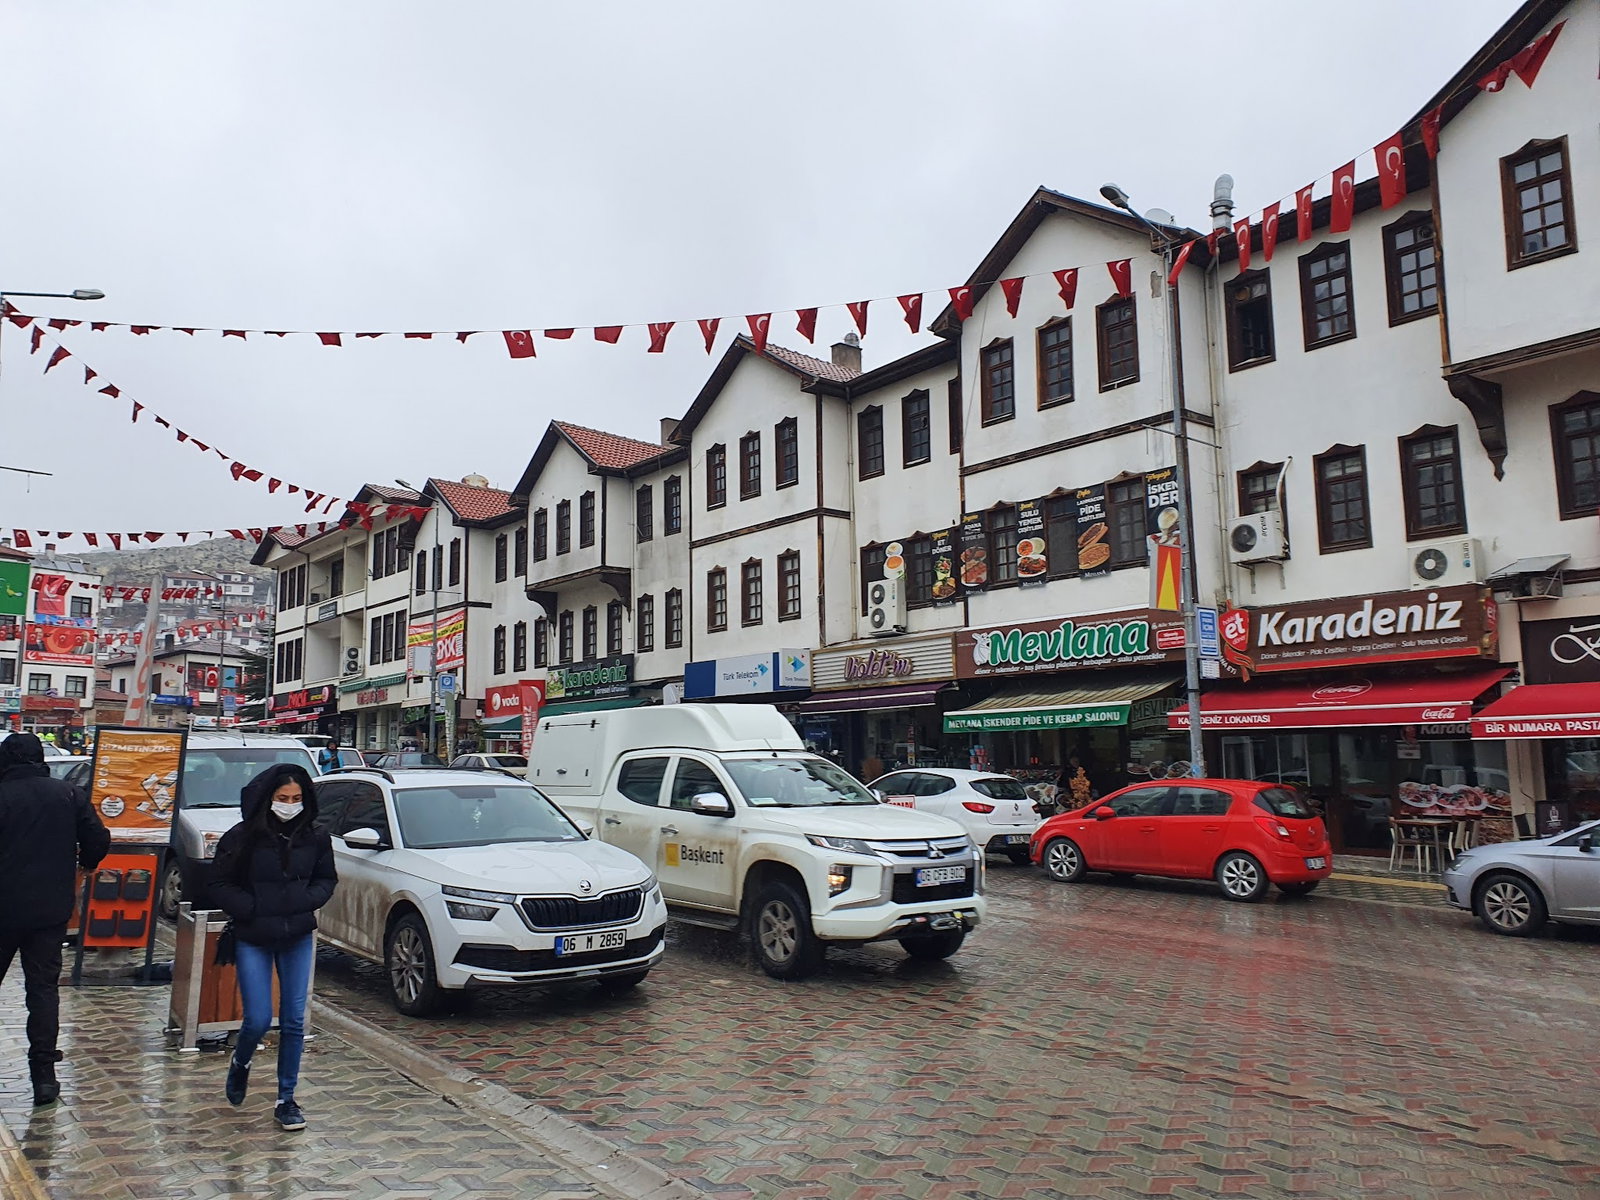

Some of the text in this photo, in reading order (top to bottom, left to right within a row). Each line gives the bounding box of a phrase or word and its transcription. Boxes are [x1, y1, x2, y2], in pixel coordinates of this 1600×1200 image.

[1148, 490, 1178, 508] DER
[1080, 504, 1101, 516] PİDE
[1225, 612, 1246, 638] et
[1258, 592, 1463, 646] Karadeniz
[989, 619, 1149, 666] Mevlana
[565, 659, 627, 689] karadeniz
[723, 670, 759, 680] Türk Telekom
[948, 712, 1120, 728] MEVLANA İSKENDER PİDE VE KEBAP SALONU
[1178, 714, 1270, 724] KADENİZ LOKANTASI
[1485, 722, 1506, 733] BİR
[1508, 722, 1562, 732] NUMARA
[681, 844, 724, 866] Başkent
[563, 932, 624, 951] 06 M 2859
